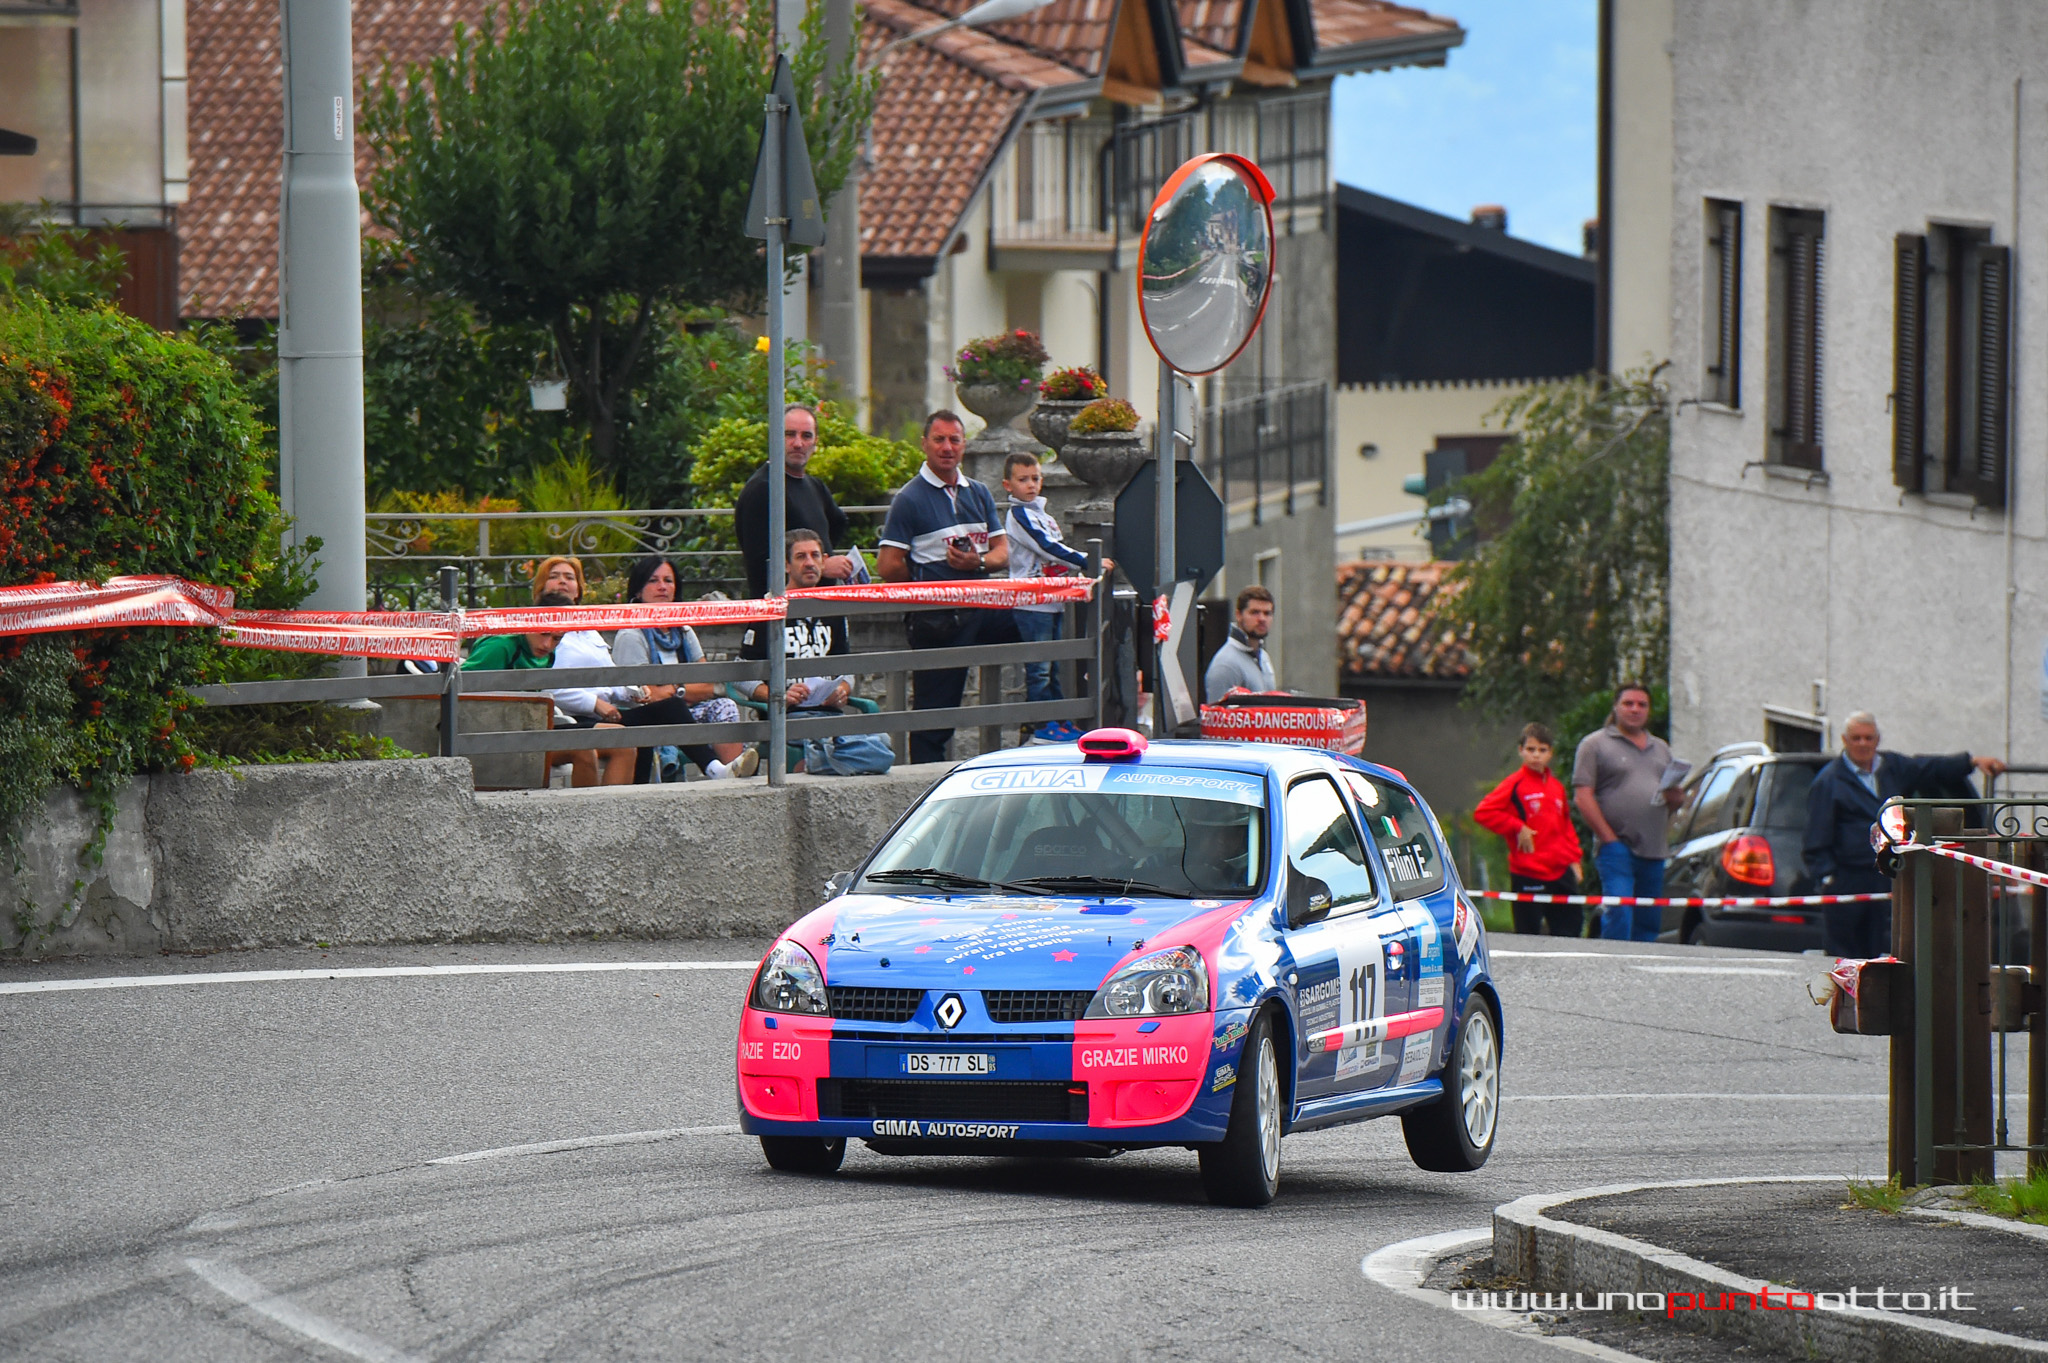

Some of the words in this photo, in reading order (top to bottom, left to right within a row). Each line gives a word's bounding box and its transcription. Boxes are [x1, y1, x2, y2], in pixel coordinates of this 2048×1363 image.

[320, 634, 341, 651] AREA
[344, 636, 365, 652] ZONA
[366, 636, 459, 658] PERICOLOSA-DANGEROUS
[971, 768, 1086, 790] GIMA
[1114, 773, 1257, 792] AUTOSPORT
[1034, 844, 1087, 856] sparco
[1382, 846, 1420, 883] Filini
[1412, 844, 1433, 878] E.
[993, 916, 1054, 928] sempre
[945, 947, 985, 964] avrai
[988, 927, 1096, 950] vagabondato
[953, 938, 993, 951] male
[998, 931, 1026, 940] che
[1031, 925, 1071, 934] vada
[982, 950, 1006, 960] tra
[1027, 937, 1073, 949] stelle
[1349, 963, 1377, 1041] 117
[772, 1042, 801, 1060] EZIO
[1081, 1048, 1138, 1068] GRAZIE
[1142, 1046, 1188, 1065] MIRKO
[910, 1055, 930, 1071] DS
[939, 1056, 961, 1071] 777
[967, 1055, 986, 1071] SL
[872, 1119, 922, 1136] GIMA
[927, 1122, 1019, 1139] AUTOSPORT
